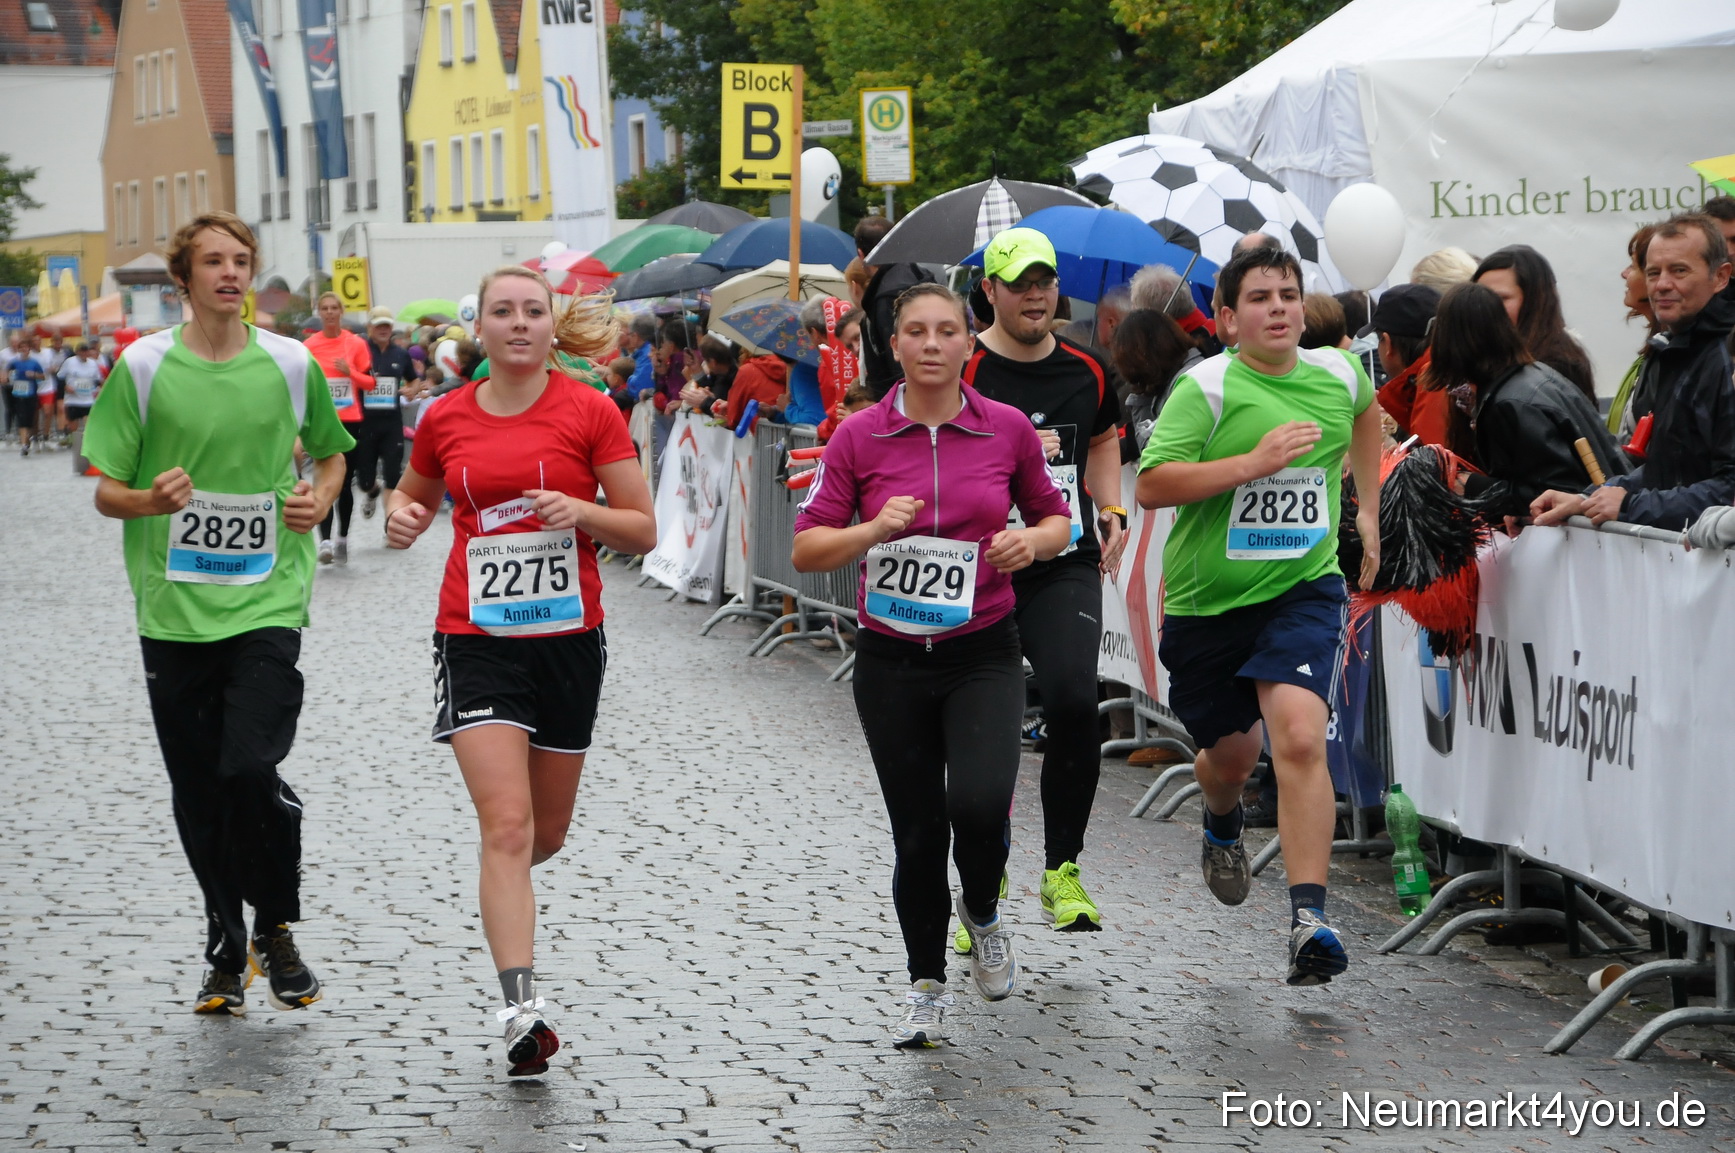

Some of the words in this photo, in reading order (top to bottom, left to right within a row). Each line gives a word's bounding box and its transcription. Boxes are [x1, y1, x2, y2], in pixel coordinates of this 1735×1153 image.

[732, 69, 793, 92] Block
[877, 102, 895, 123] H
[742, 102, 782, 161] B
[827, 122, 848, 132] Gasse
[1429, 178, 1570, 219] Kinder
[1584, 173, 1731, 214] brauch
[334, 260, 363, 270] Block
[341, 273, 360, 300] C
[843, 350, 853, 379] BKK
[1267, 476, 1311, 486] Neumarkt
[185, 499, 208, 510] RTL
[210, 502, 260, 512] Neumarkt
[497, 504, 523, 520] DEHN
[1238, 489, 1319, 524] 2828
[180, 512, 267, 550] 2829
[468, 546, 504, 558] PARTL
[506, 541, 558, 554] Neumarkt
[1247, 533, 1310, 549] Christoph
[908, 545, 959, 560] Neumarkt
[195, 556, 247, 572] Samuel
[480, 554, 569, 599] 2275
[876, 557, 965, 600] 2029
[502, 605, 552, 622] Annika
[888, 601, 944, 623] Andreas
[457, 706, 494, 720] hummel
